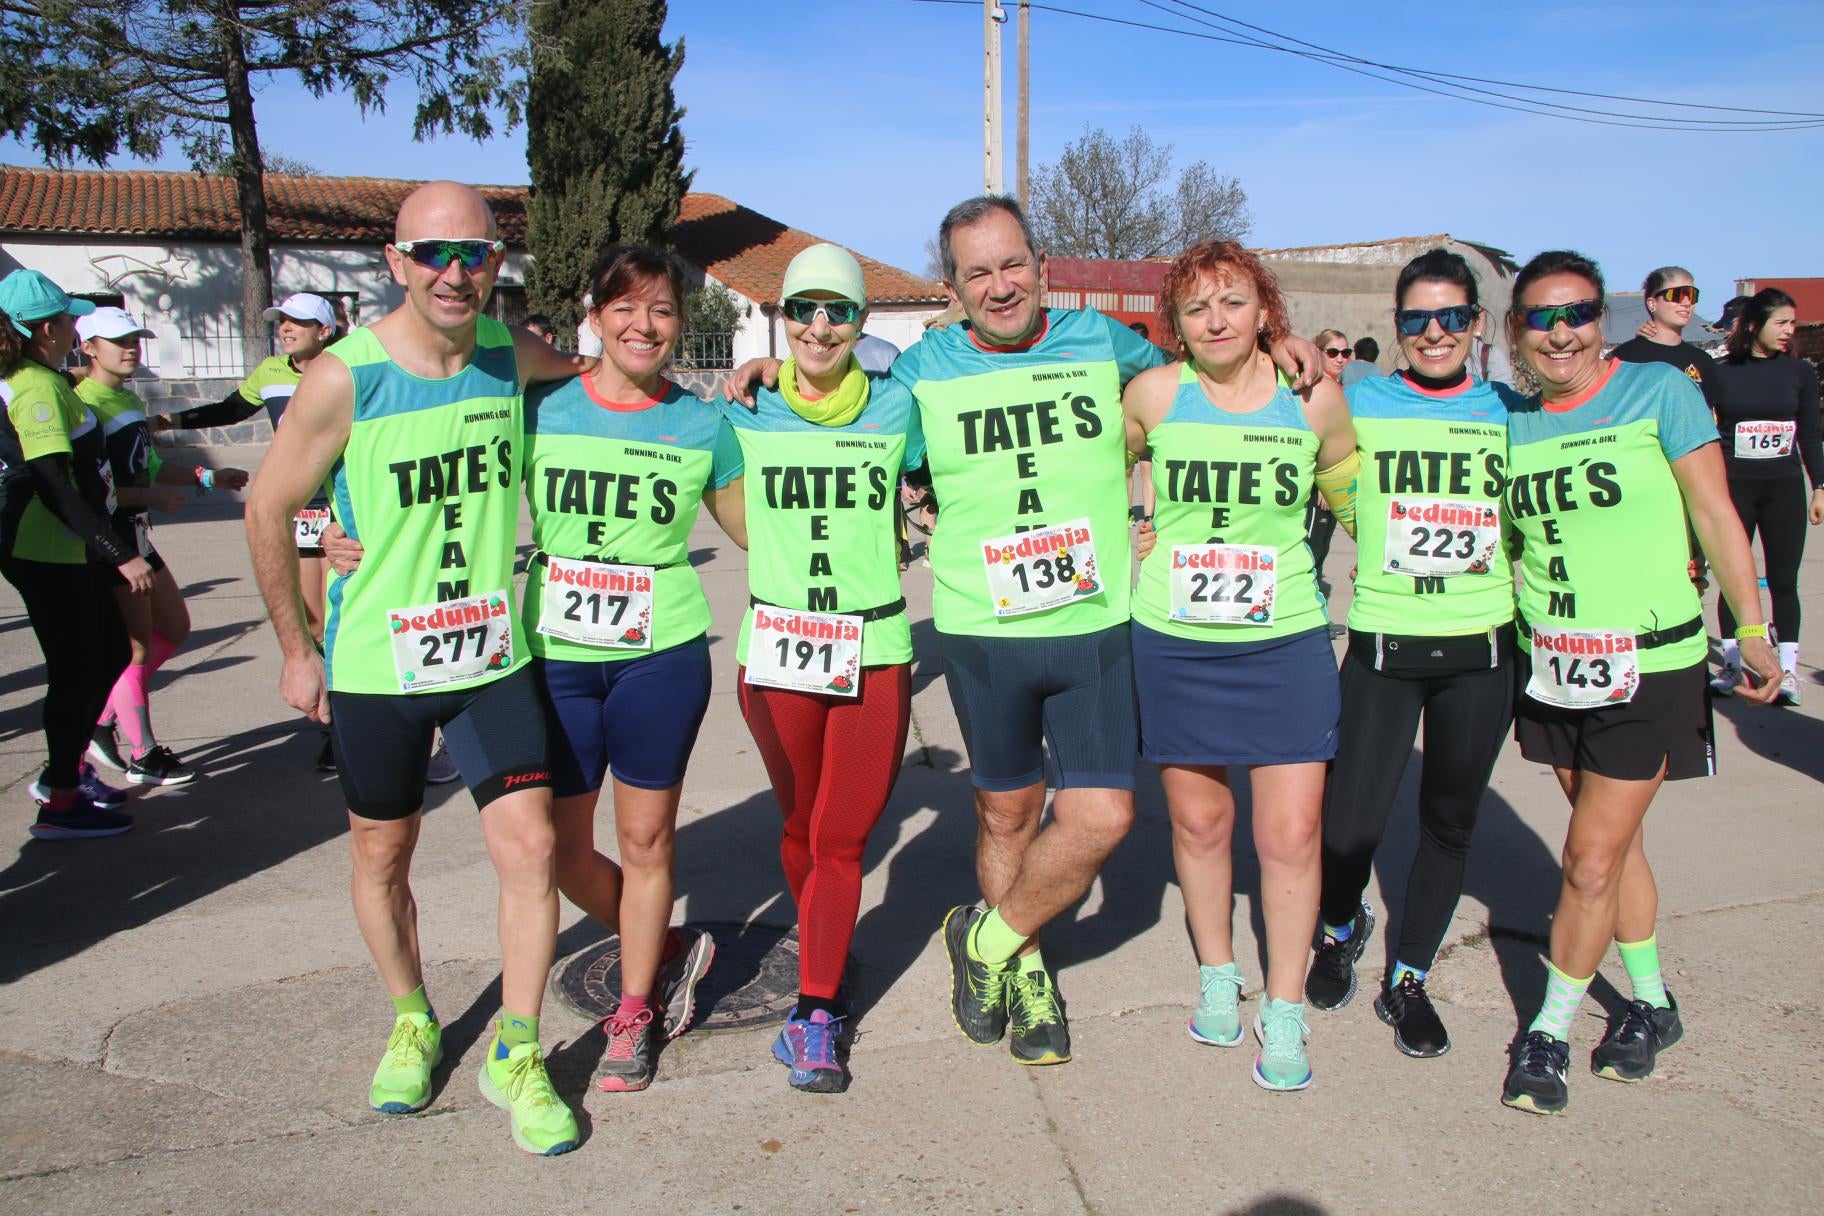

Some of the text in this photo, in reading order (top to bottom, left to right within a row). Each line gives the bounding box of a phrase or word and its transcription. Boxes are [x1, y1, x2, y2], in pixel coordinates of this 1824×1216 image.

[1032, 372, 1065, 382] RUNNING
[1072, 370, 1088, 378] BIKE
[464, 410, 494, 423] RUNNING
[1449, 427, 1481, 436] RUNNING
[624, 447, 657, 459] RUNNING
[666, 453, 682, 463] BIKE
[836, 440, 867, 449] RUNNING
[1243, 434, 1278, 443] RUNNING
[1287, 437, 1303, 446] BIKE
[1561, 438, 1590, 450] RUNNING
[1599, 435, 1617, 444] BIKE
[1748, 434, 1782, 449] 165
[1391, 501, 1497, 527] bedunia
[984, 527, 1091, 565] bedunia
[1409, 526, 1476, 559] 223
[549, 563, 650, 593] bedunia
[1012, 553, 1076, 593] 138
[1190, 572, 1253, 603] 222
[391, 599, 507, 634] bedunia
[564, 590, 629, 626] 217
[755, 610, 858, 641] bedunia
[420, 624, 488, 667] 277
[775, 637, 833, 673] 191
[1533, 628, 1633, 654] bedunia
[1549, 656, 1612, 688] 143
